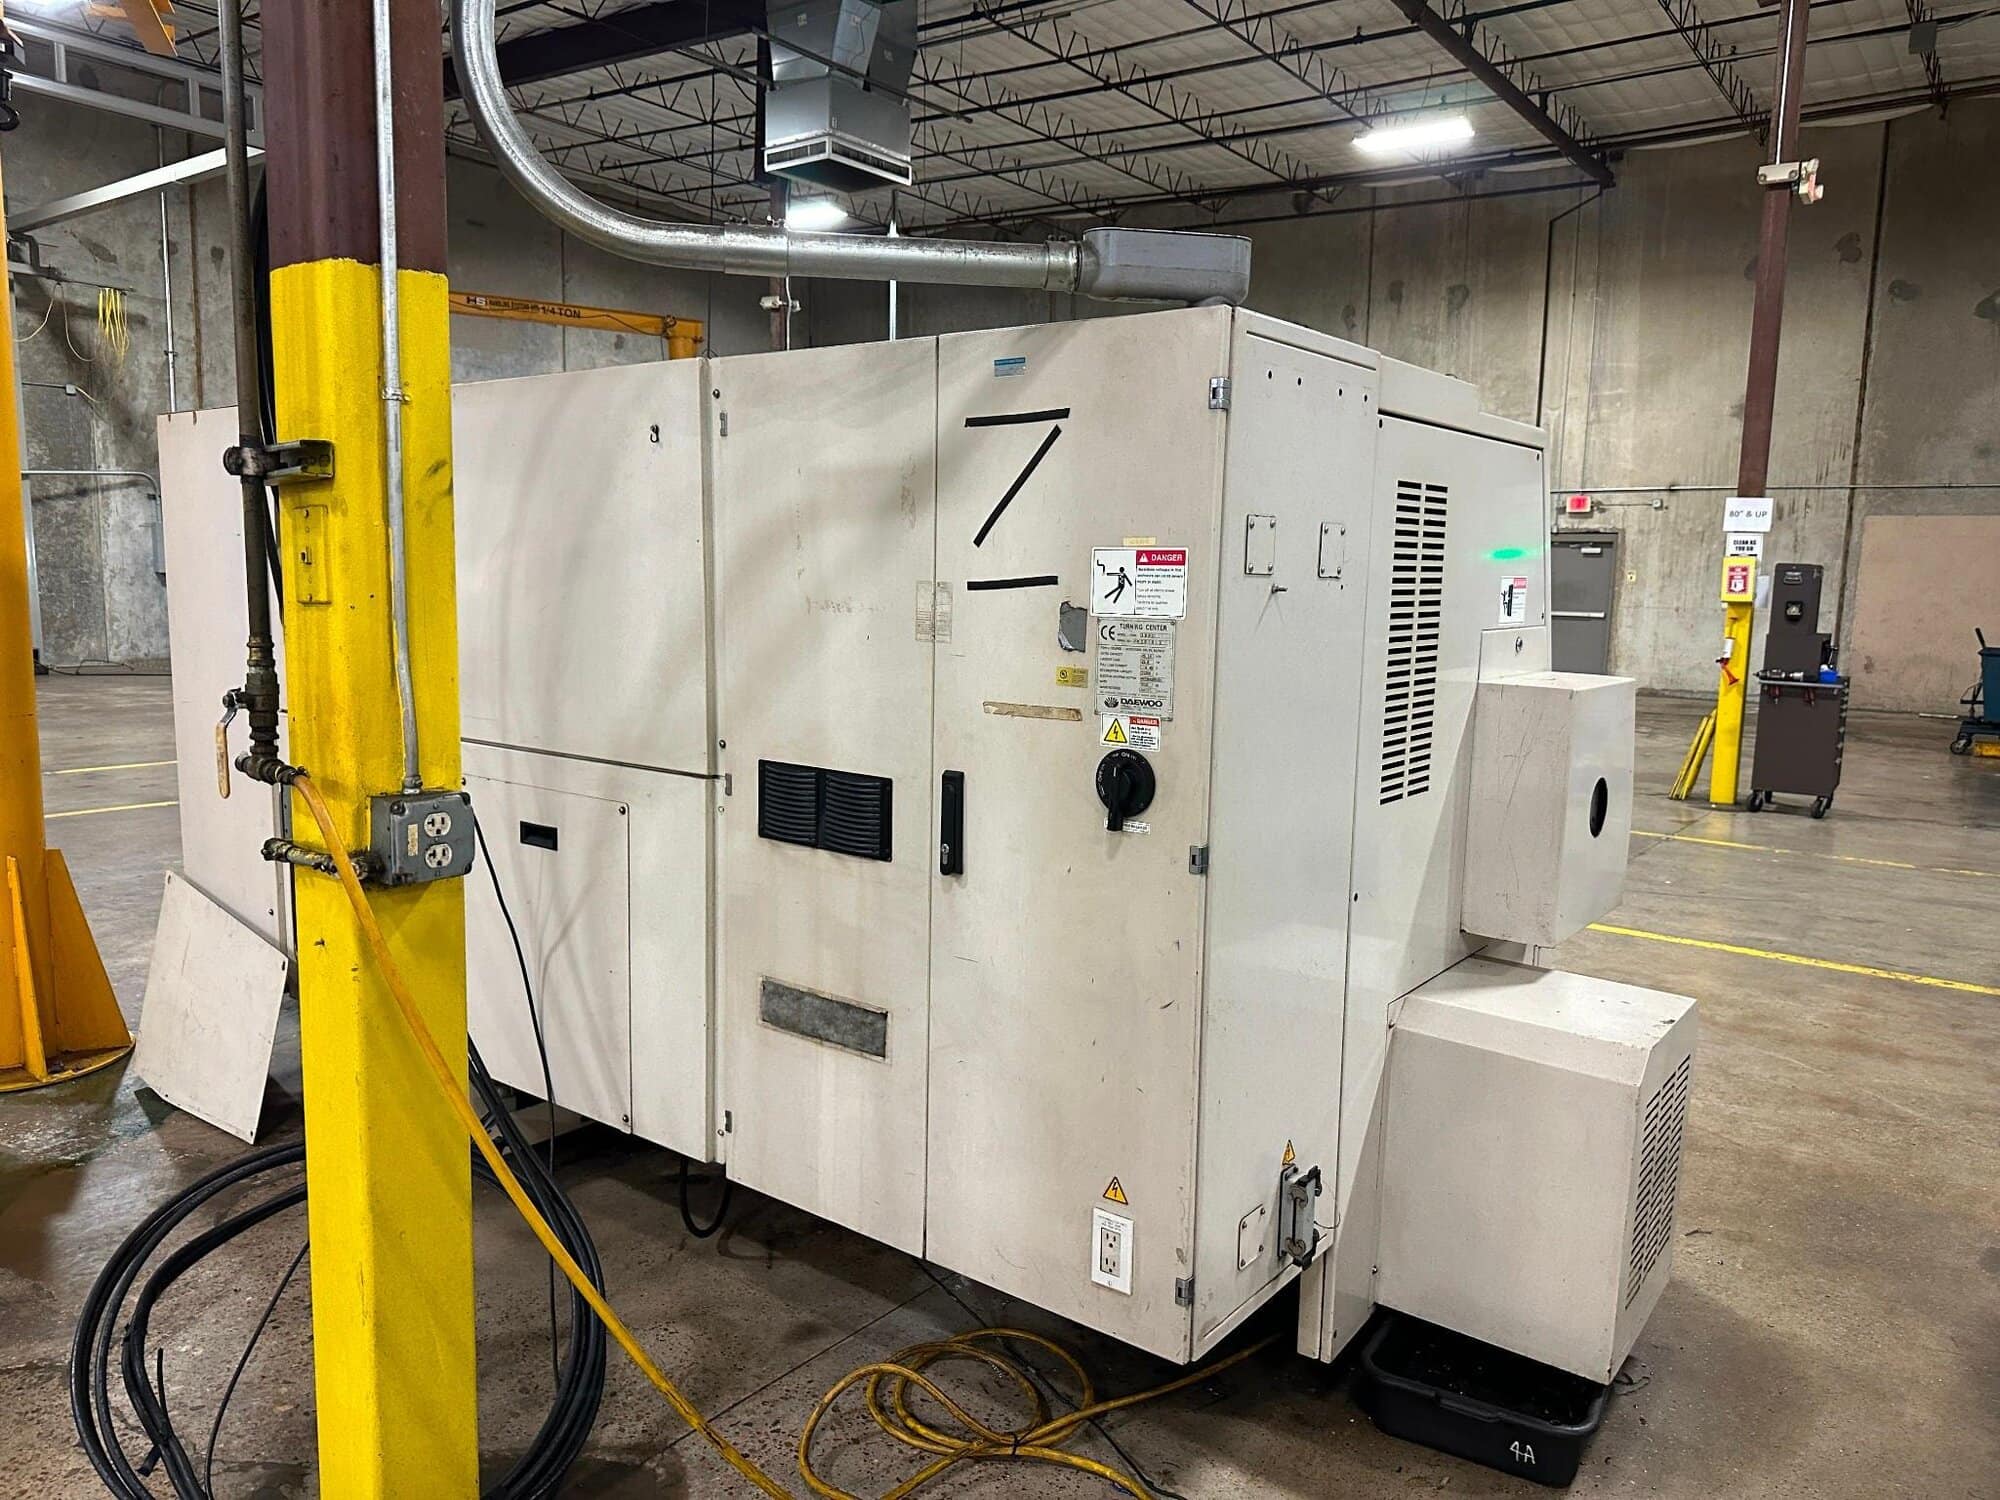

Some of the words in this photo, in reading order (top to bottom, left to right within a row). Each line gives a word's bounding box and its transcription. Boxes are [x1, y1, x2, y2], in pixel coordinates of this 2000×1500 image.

[541, 305, 556, 315] 1/4
[557, 307, 581, 318] TON
[1755, 510, 1768, 518] UP
[1151, 553, 1183, 562] DANGER
[1120, 698, 1163, 707] DAEWOO
[1509, 1440, 1536, 1465] 4A
